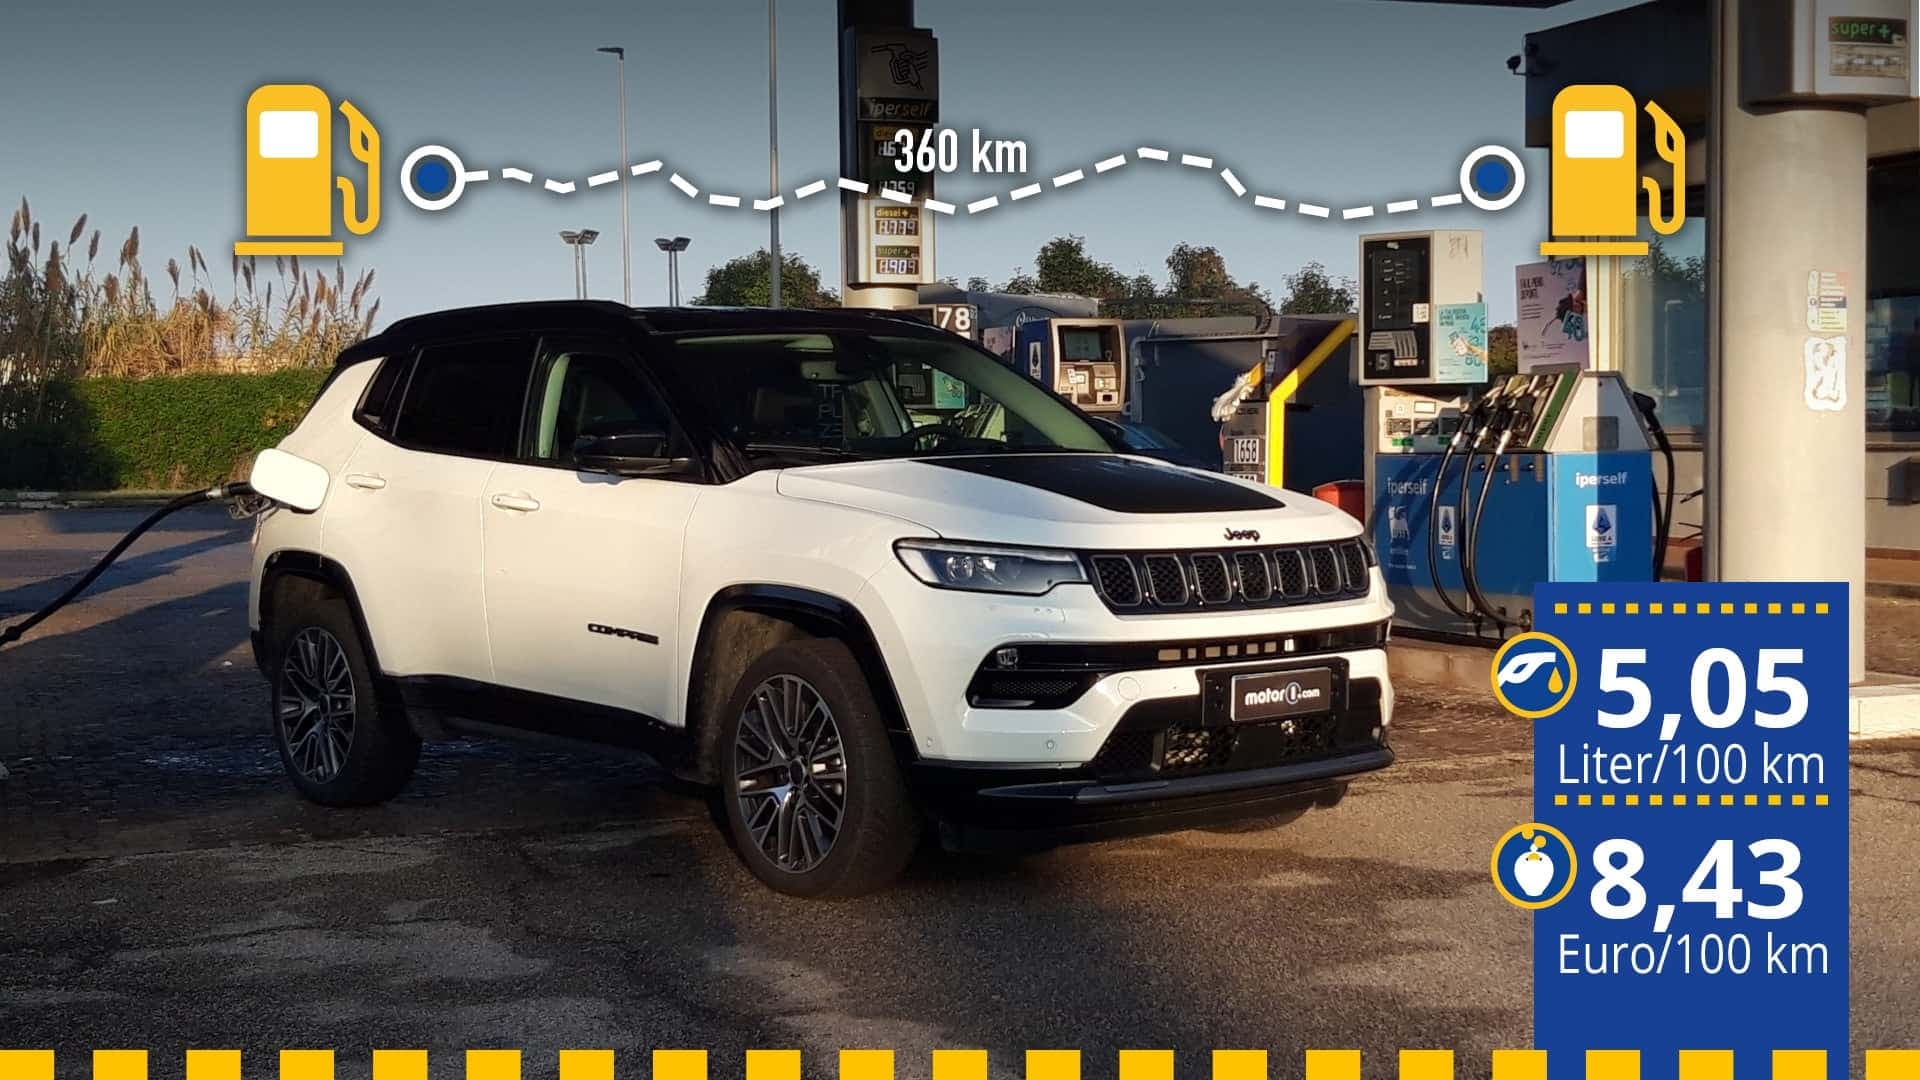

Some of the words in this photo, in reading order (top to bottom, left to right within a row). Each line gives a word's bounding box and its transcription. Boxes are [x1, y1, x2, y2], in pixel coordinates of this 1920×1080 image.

[869, 98, 929, 118] iperself
[1378, 353, 1389, 370] 5
[1235, 440, 1257, 463] 1658
[1387, 477, 1428, 497] iperself
[1576, 472, 1628, 488] iperself
[1223, 527, 1261, 543] Jeep
[588, 623, 659, 645] COMPASS
